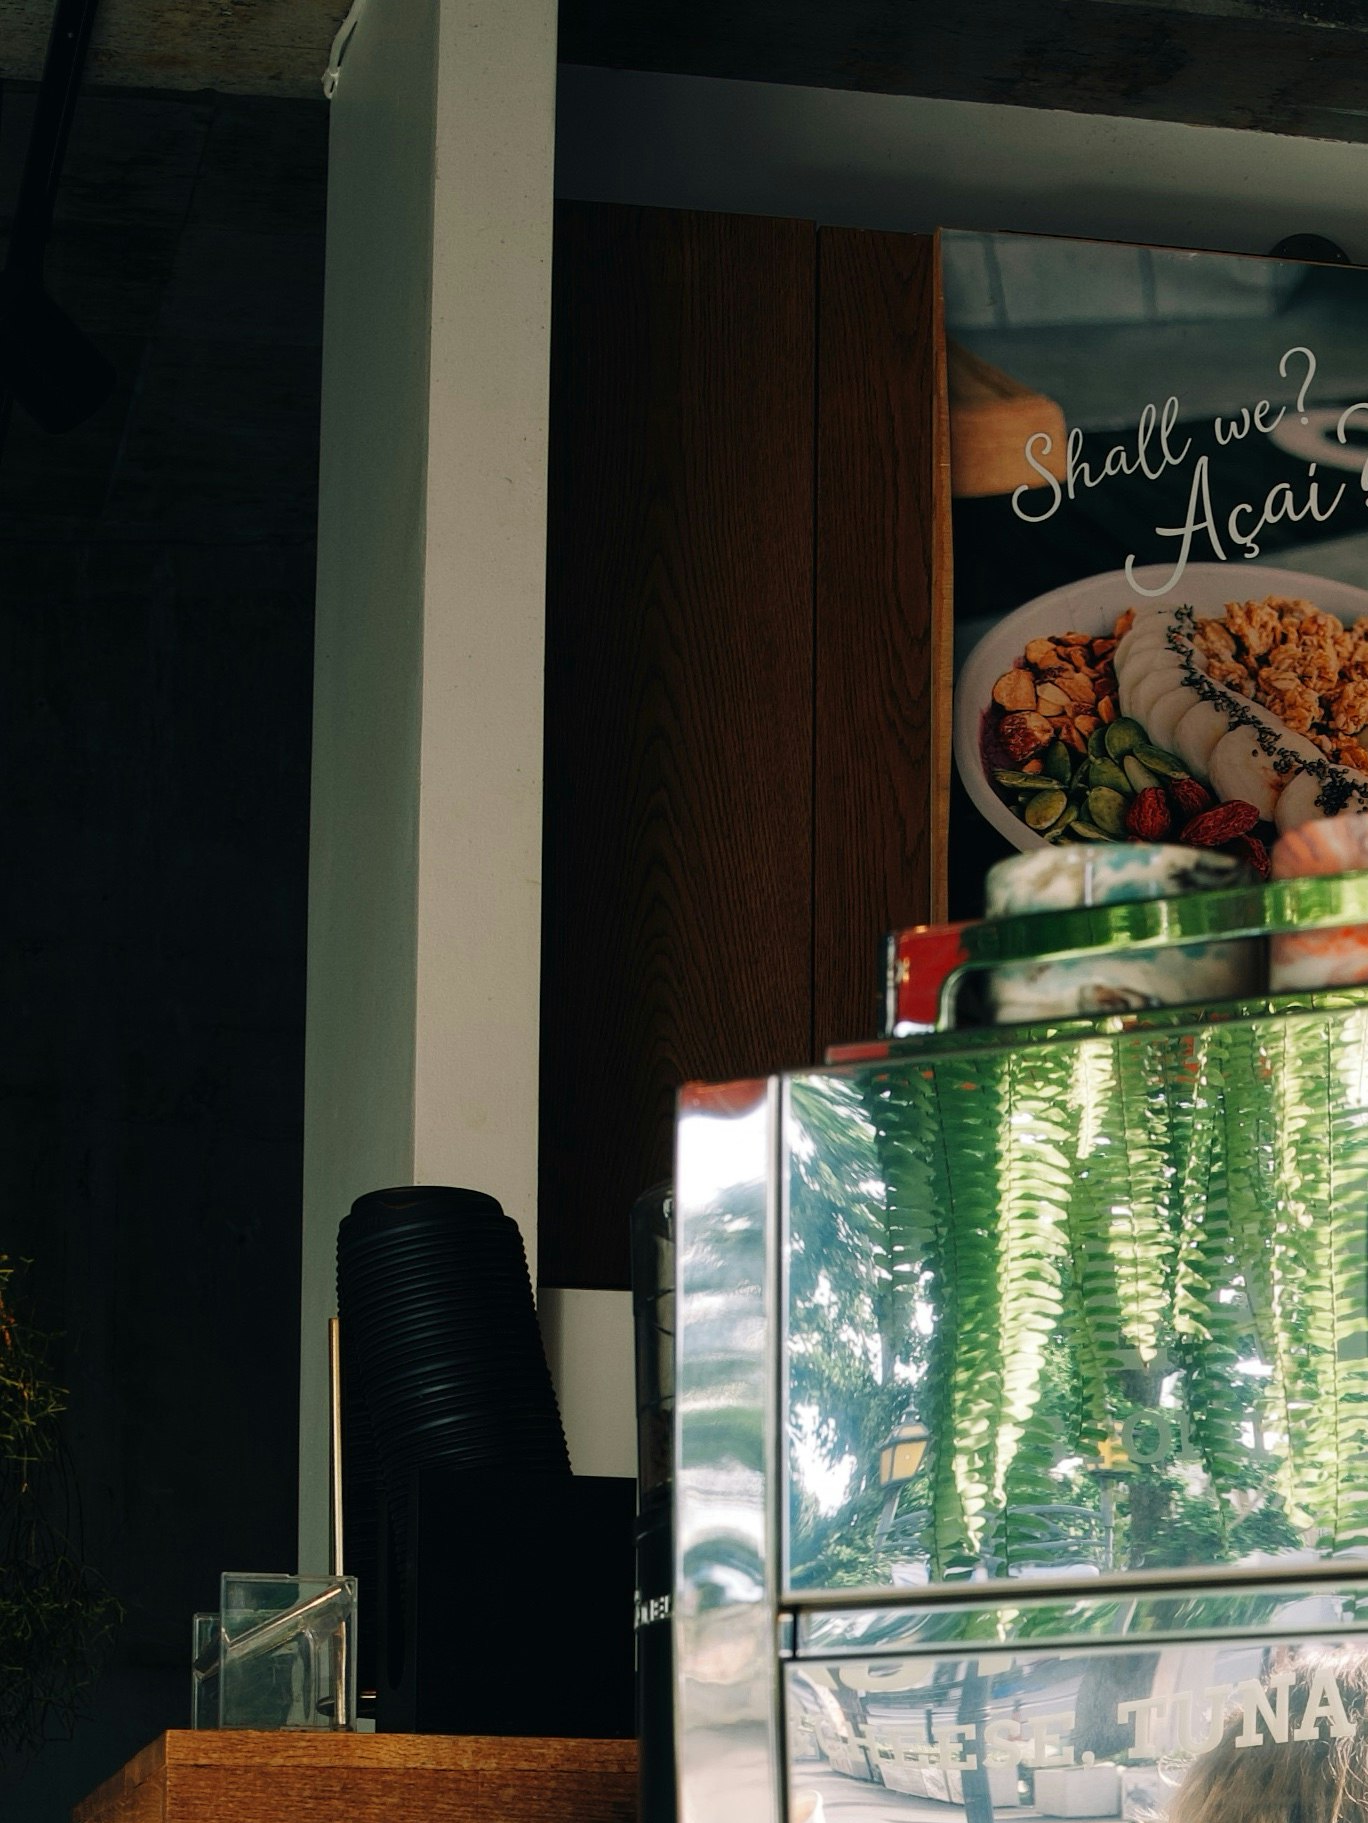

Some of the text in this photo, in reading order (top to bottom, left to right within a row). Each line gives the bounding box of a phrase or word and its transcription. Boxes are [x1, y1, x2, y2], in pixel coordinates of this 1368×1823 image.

[1012, 396, 1191, 522] Shall
[1215, 347, 1317, 426] we?
[1117, 1671, 1357, 1760] TUNA
